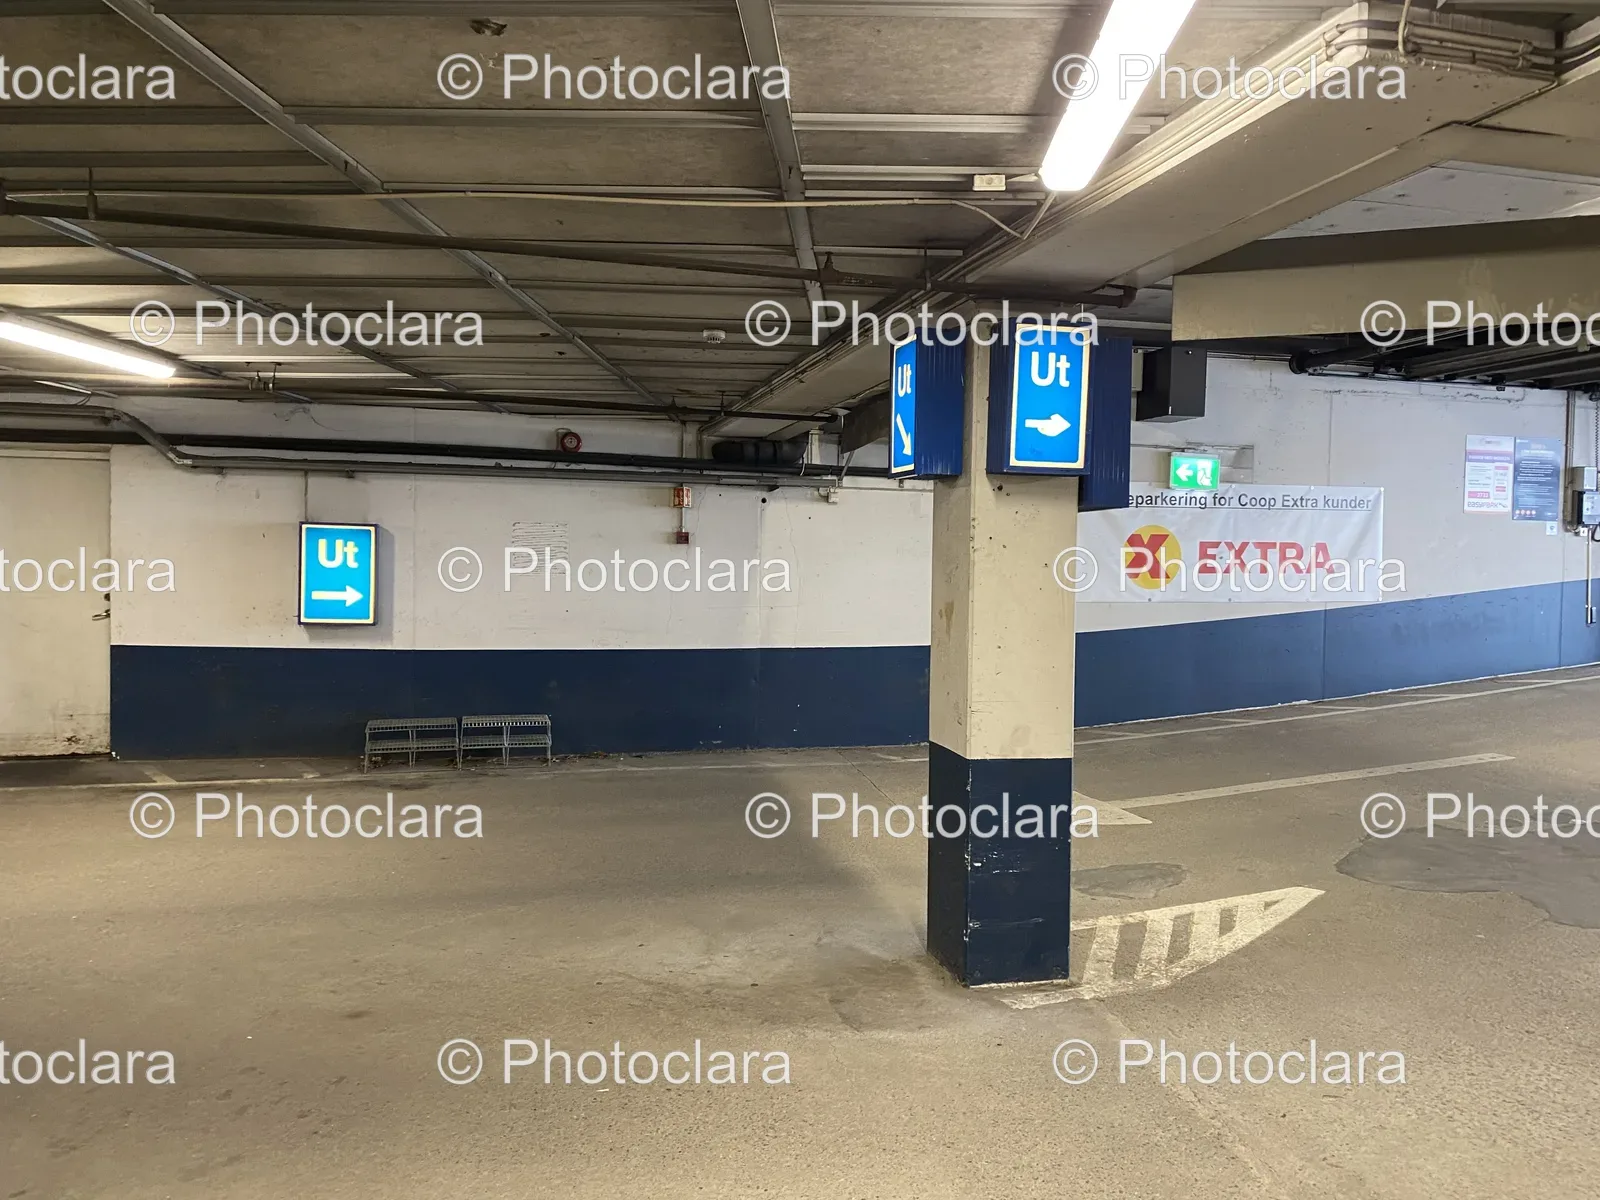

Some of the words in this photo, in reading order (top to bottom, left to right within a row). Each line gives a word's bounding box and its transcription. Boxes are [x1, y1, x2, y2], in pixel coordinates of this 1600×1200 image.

[897, 364, 912, 397] Ut
[1030, 351, 1070, 387] Ut
[1212, 493, 1234, 507] for
[1238, 493, 1277, 511] Coop
[1282, 494, 1319, 508] Extra
[1323, 495, 1372, 510] kunder
[318, 538, 359, 569] Ut
[1198, 540, 1335, 575] EXTRA
